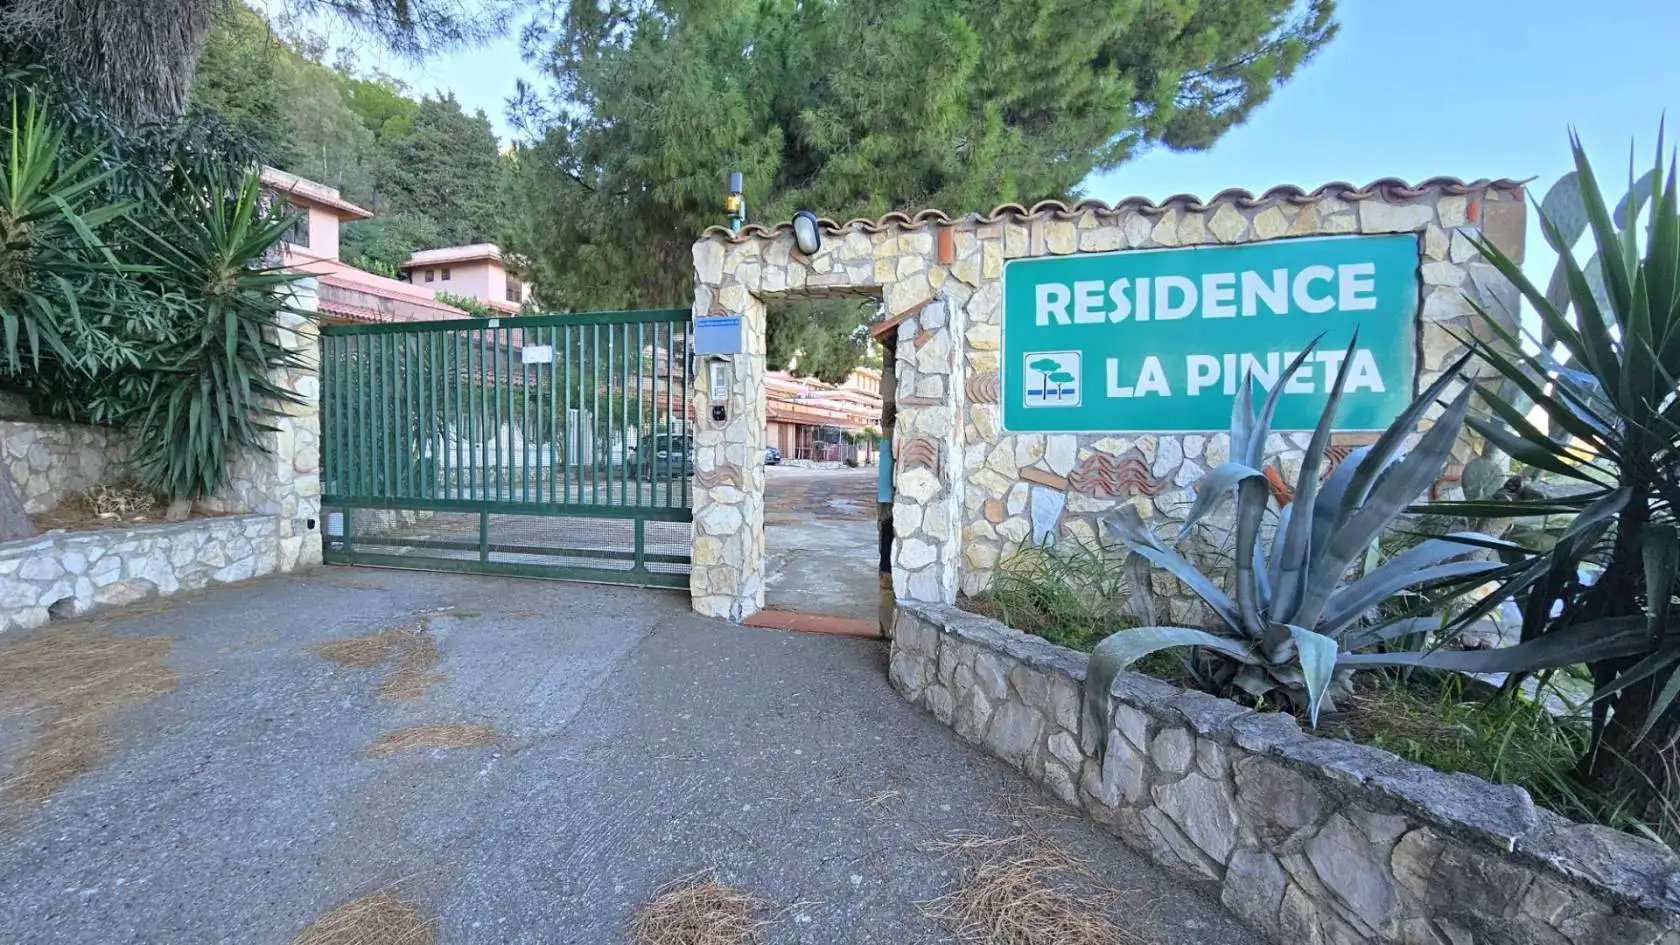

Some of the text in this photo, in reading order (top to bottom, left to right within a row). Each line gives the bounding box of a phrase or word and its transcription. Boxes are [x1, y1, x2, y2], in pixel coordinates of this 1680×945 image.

[1035, 262, 1377, 326] RESIDENCE
[1106, 349, 1385, 398] LA PINETA
